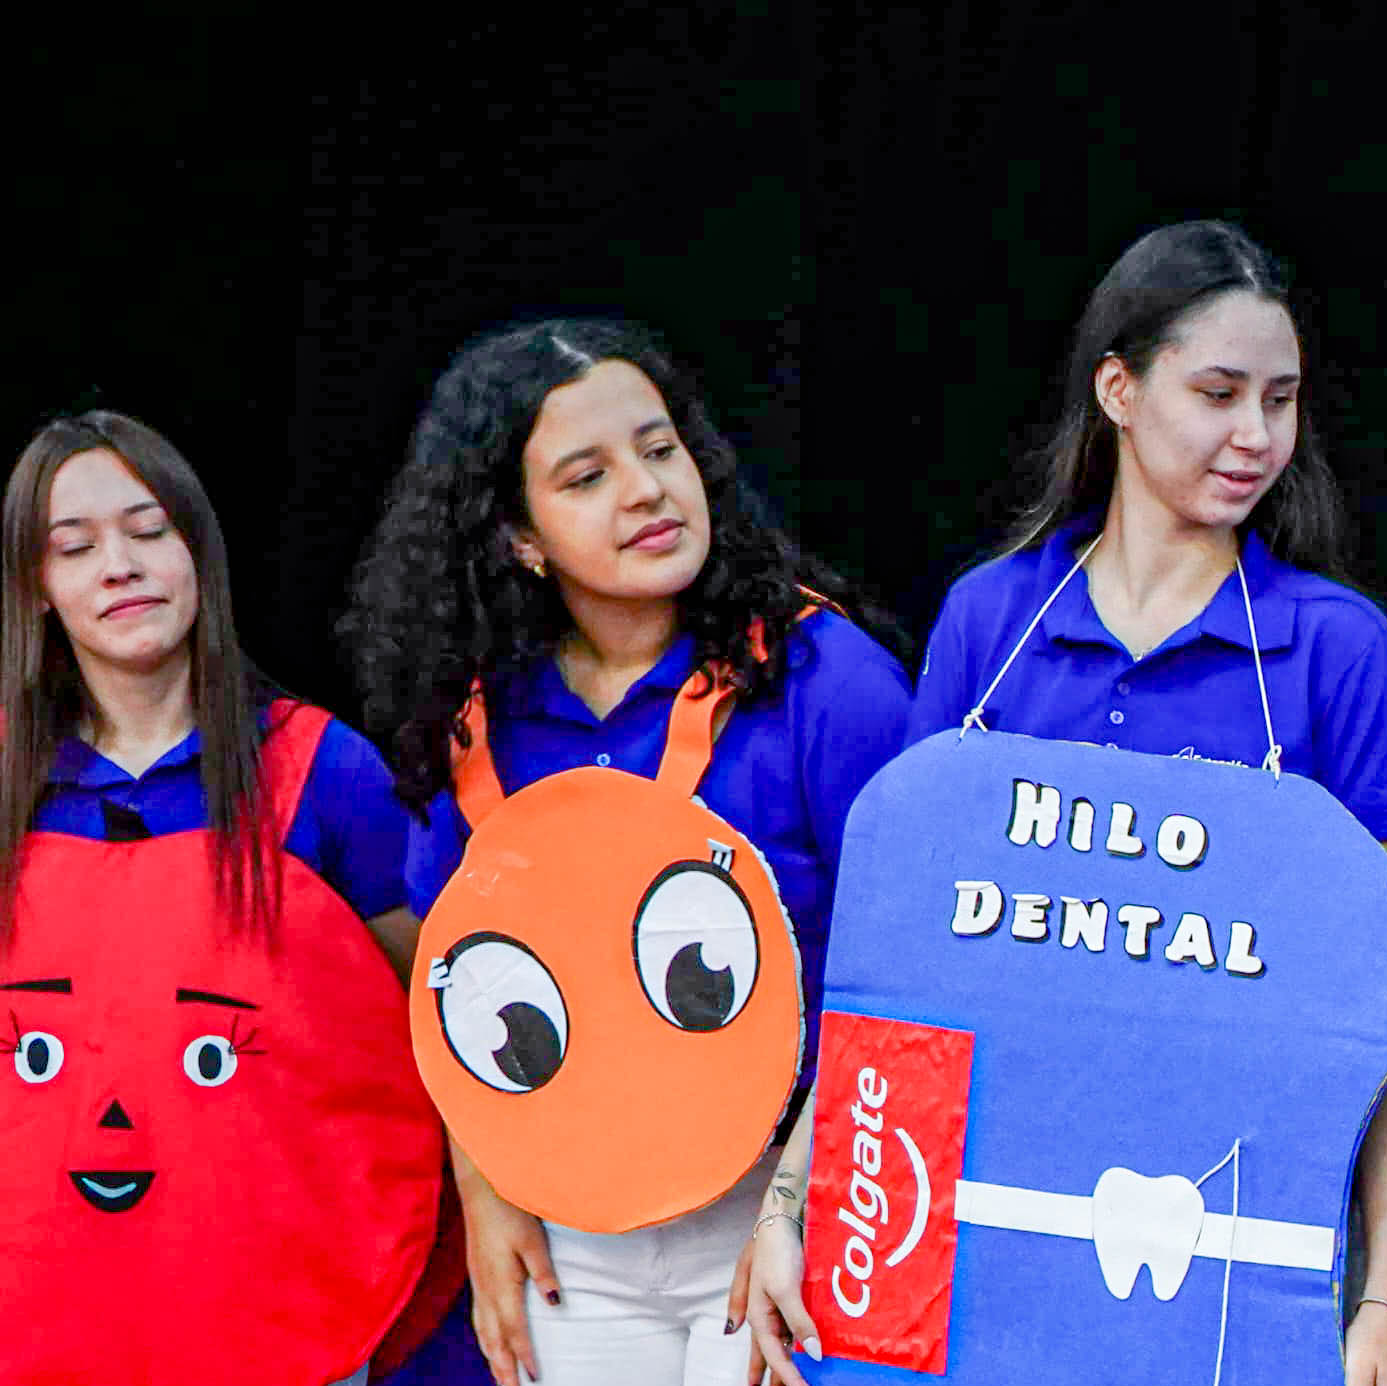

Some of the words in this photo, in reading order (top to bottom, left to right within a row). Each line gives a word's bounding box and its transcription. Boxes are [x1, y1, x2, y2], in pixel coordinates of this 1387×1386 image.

[1007, 778, 1210, 871] HILO
[951, 880, 1266, 978] DENTAL
[831, 1065, 889, 1319] Colgate
